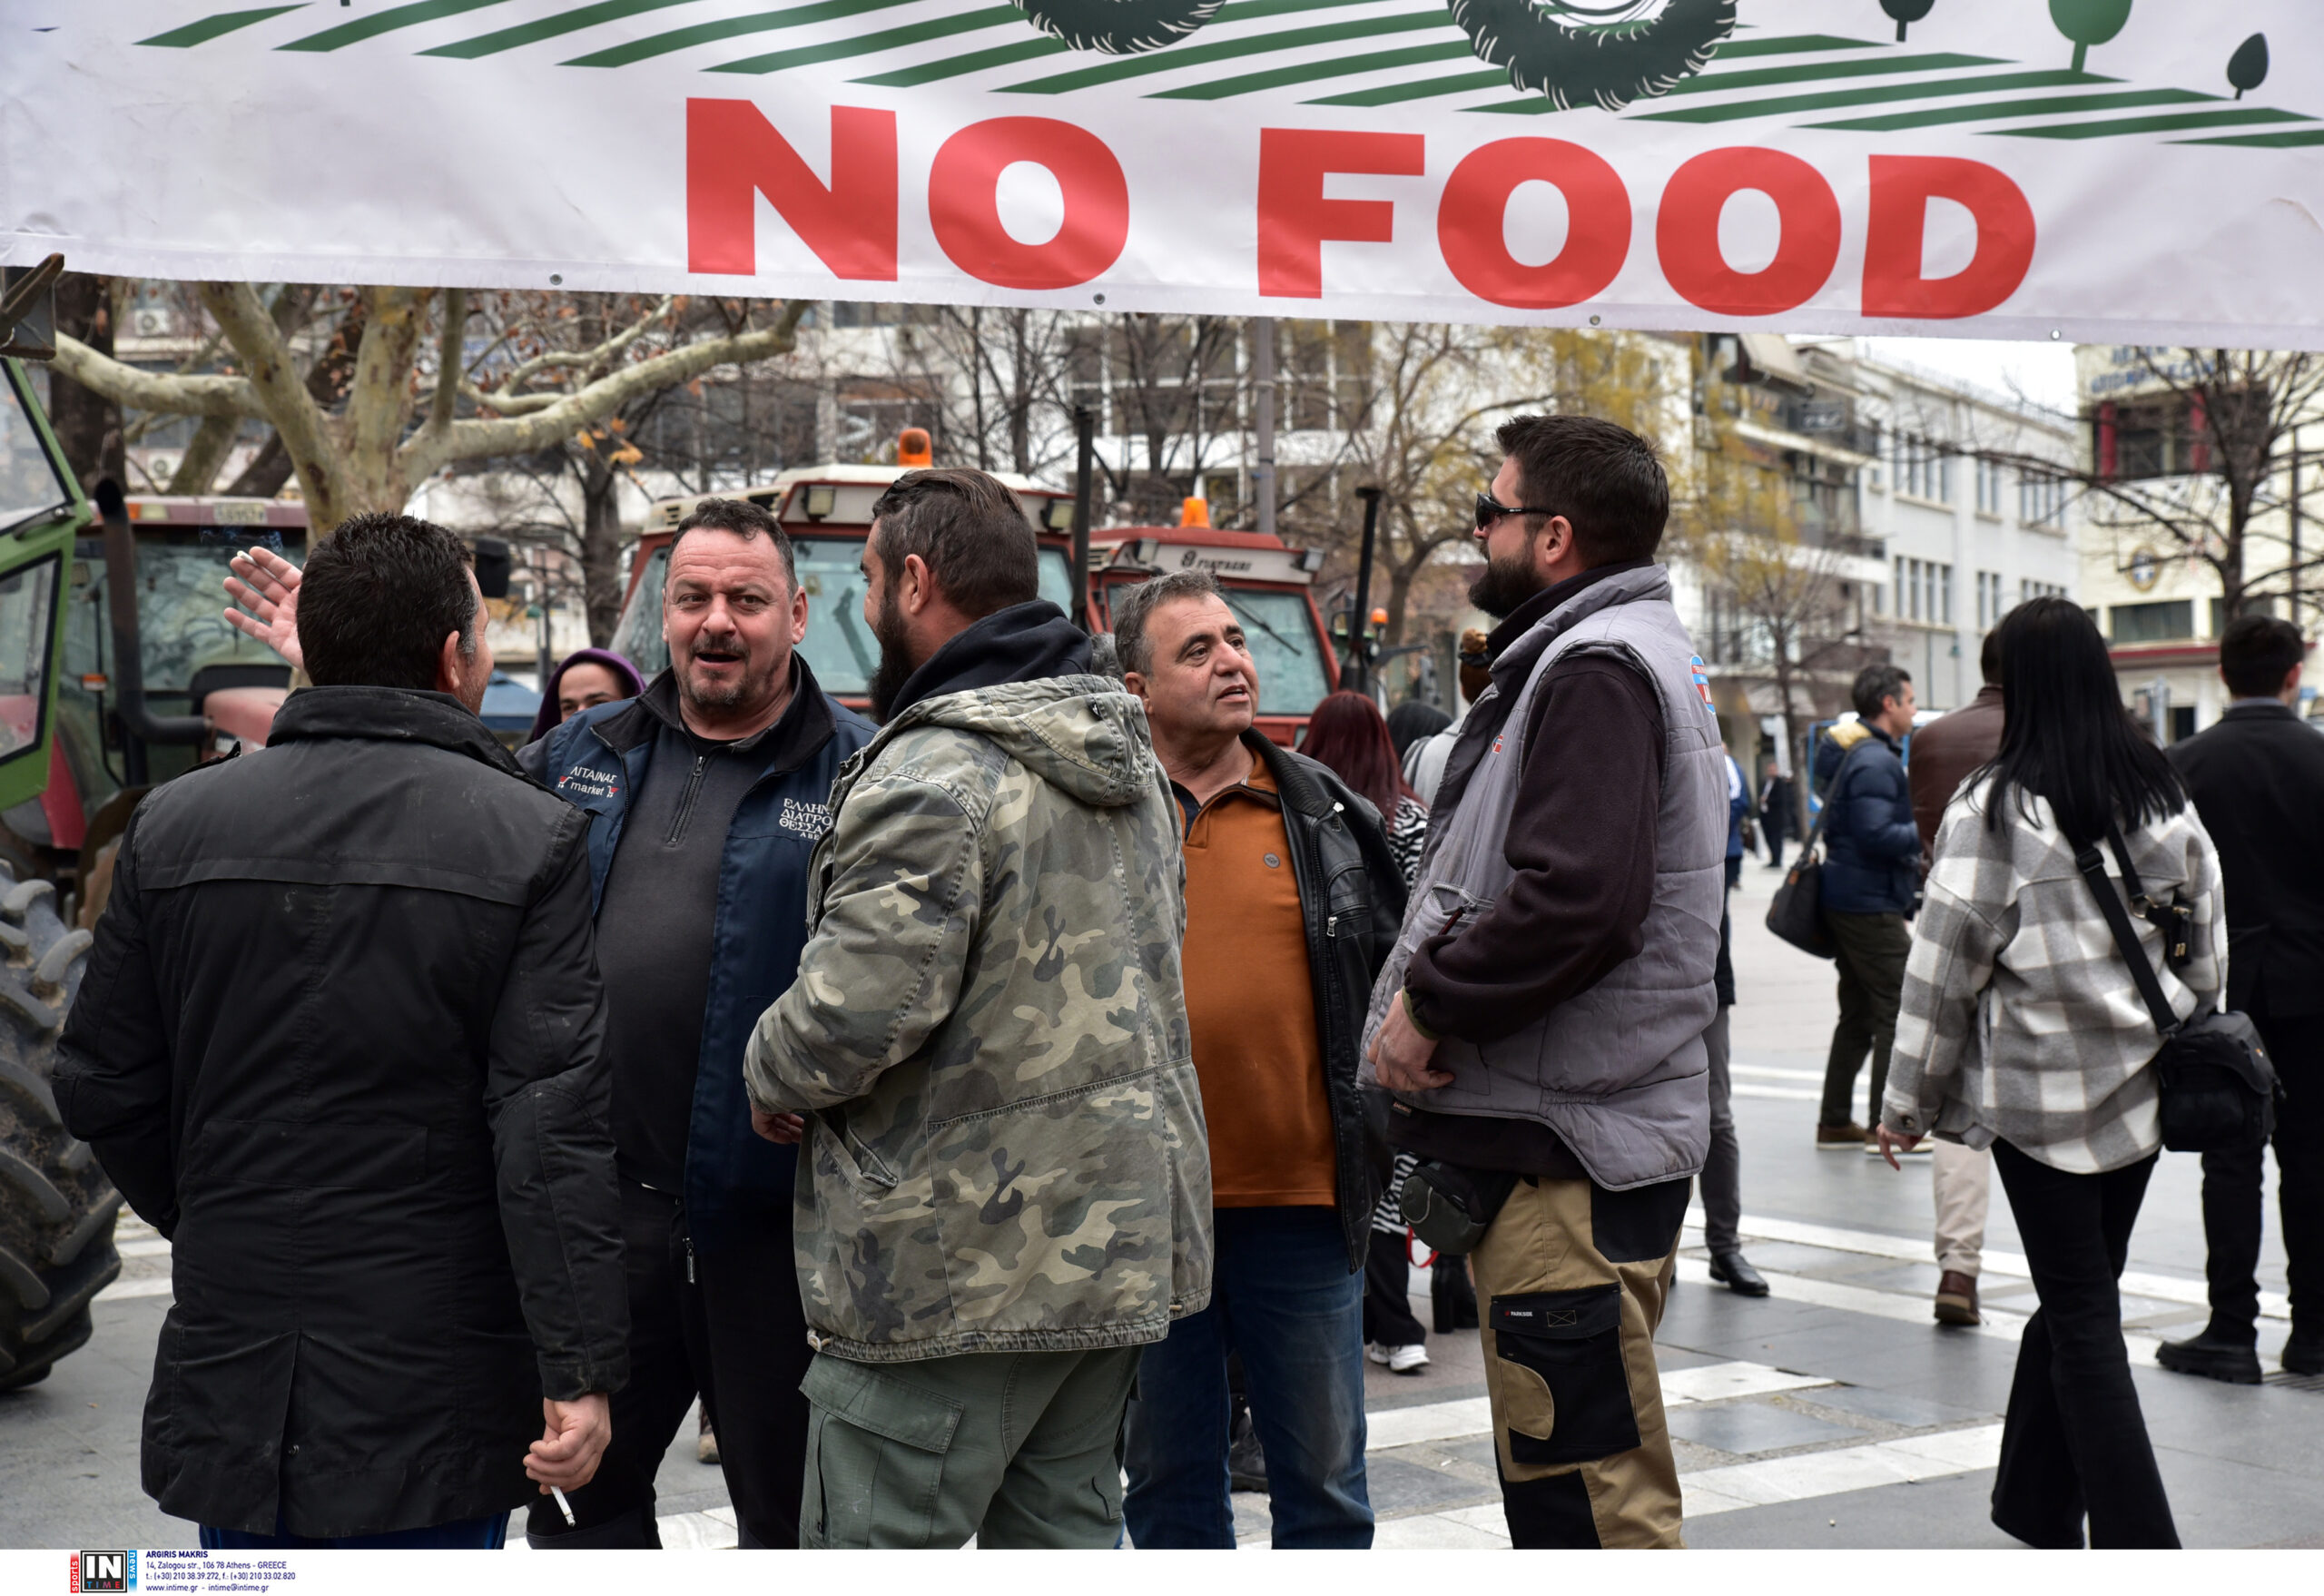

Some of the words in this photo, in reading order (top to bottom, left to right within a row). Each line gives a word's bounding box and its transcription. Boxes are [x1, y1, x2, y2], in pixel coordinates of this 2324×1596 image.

[686, 98, 1130, 291] NO
[1257, 127, 2036, 320] FOOD
[570, 781, 605, 796] market
